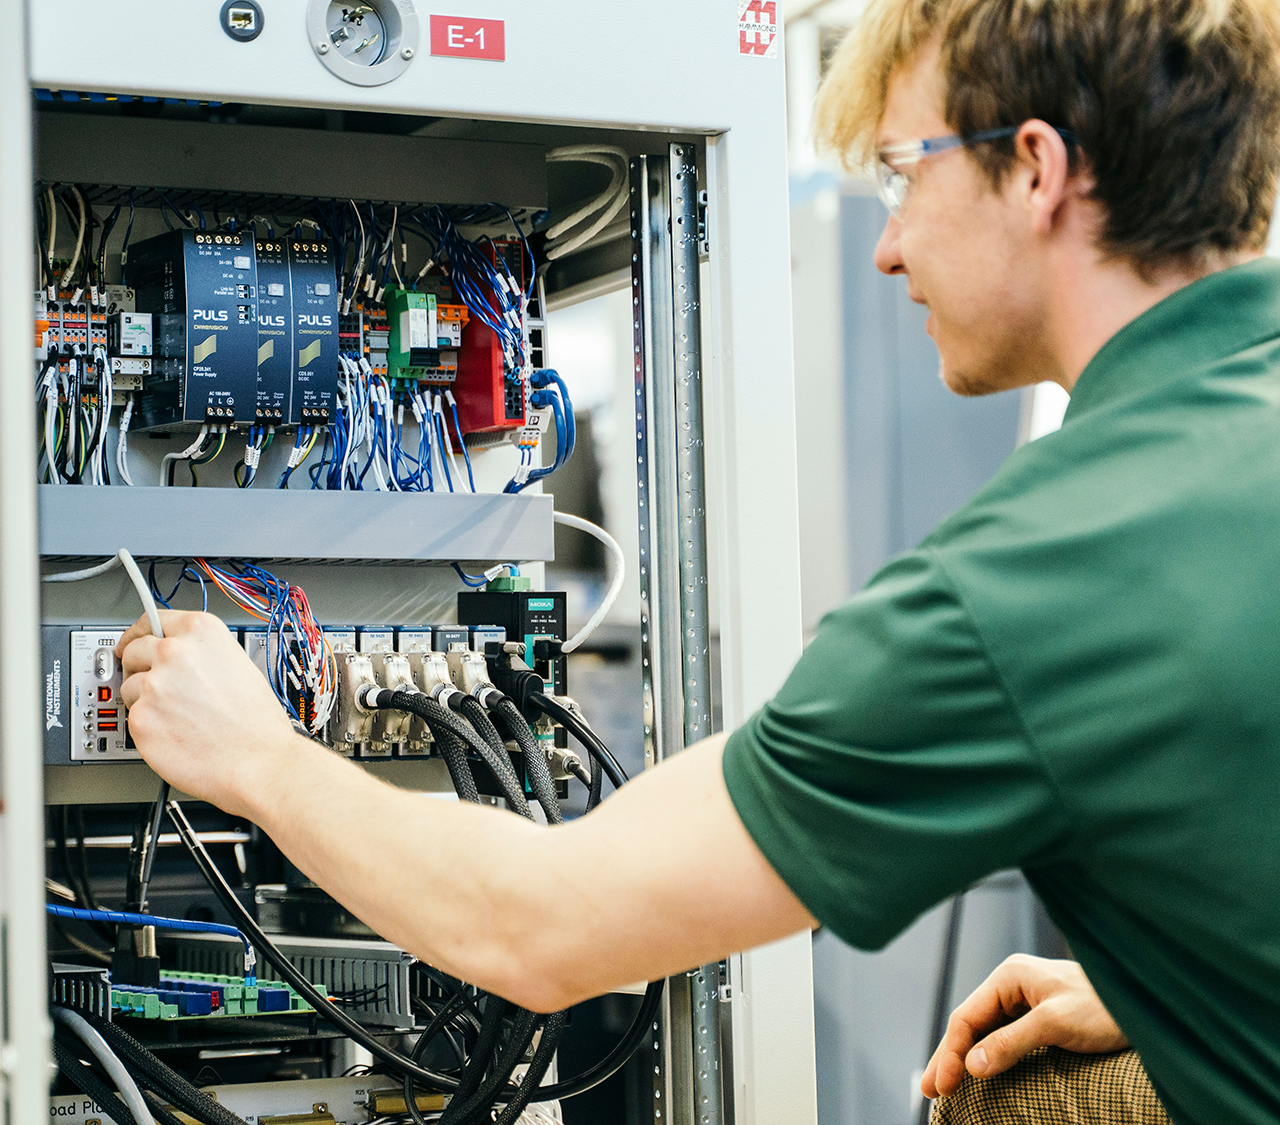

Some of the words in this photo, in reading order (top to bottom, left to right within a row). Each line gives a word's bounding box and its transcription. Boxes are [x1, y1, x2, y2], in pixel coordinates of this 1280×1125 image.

[738, 22, 776, 32] HAMMOND
[448, 24, 484, 50] E-1
[193, 309, 228, 321] PULS
[298, 314, 332, 326] PULS
[50, 1102, 76, 1116] oad
[83, 1101, 104, 1114] Pla
